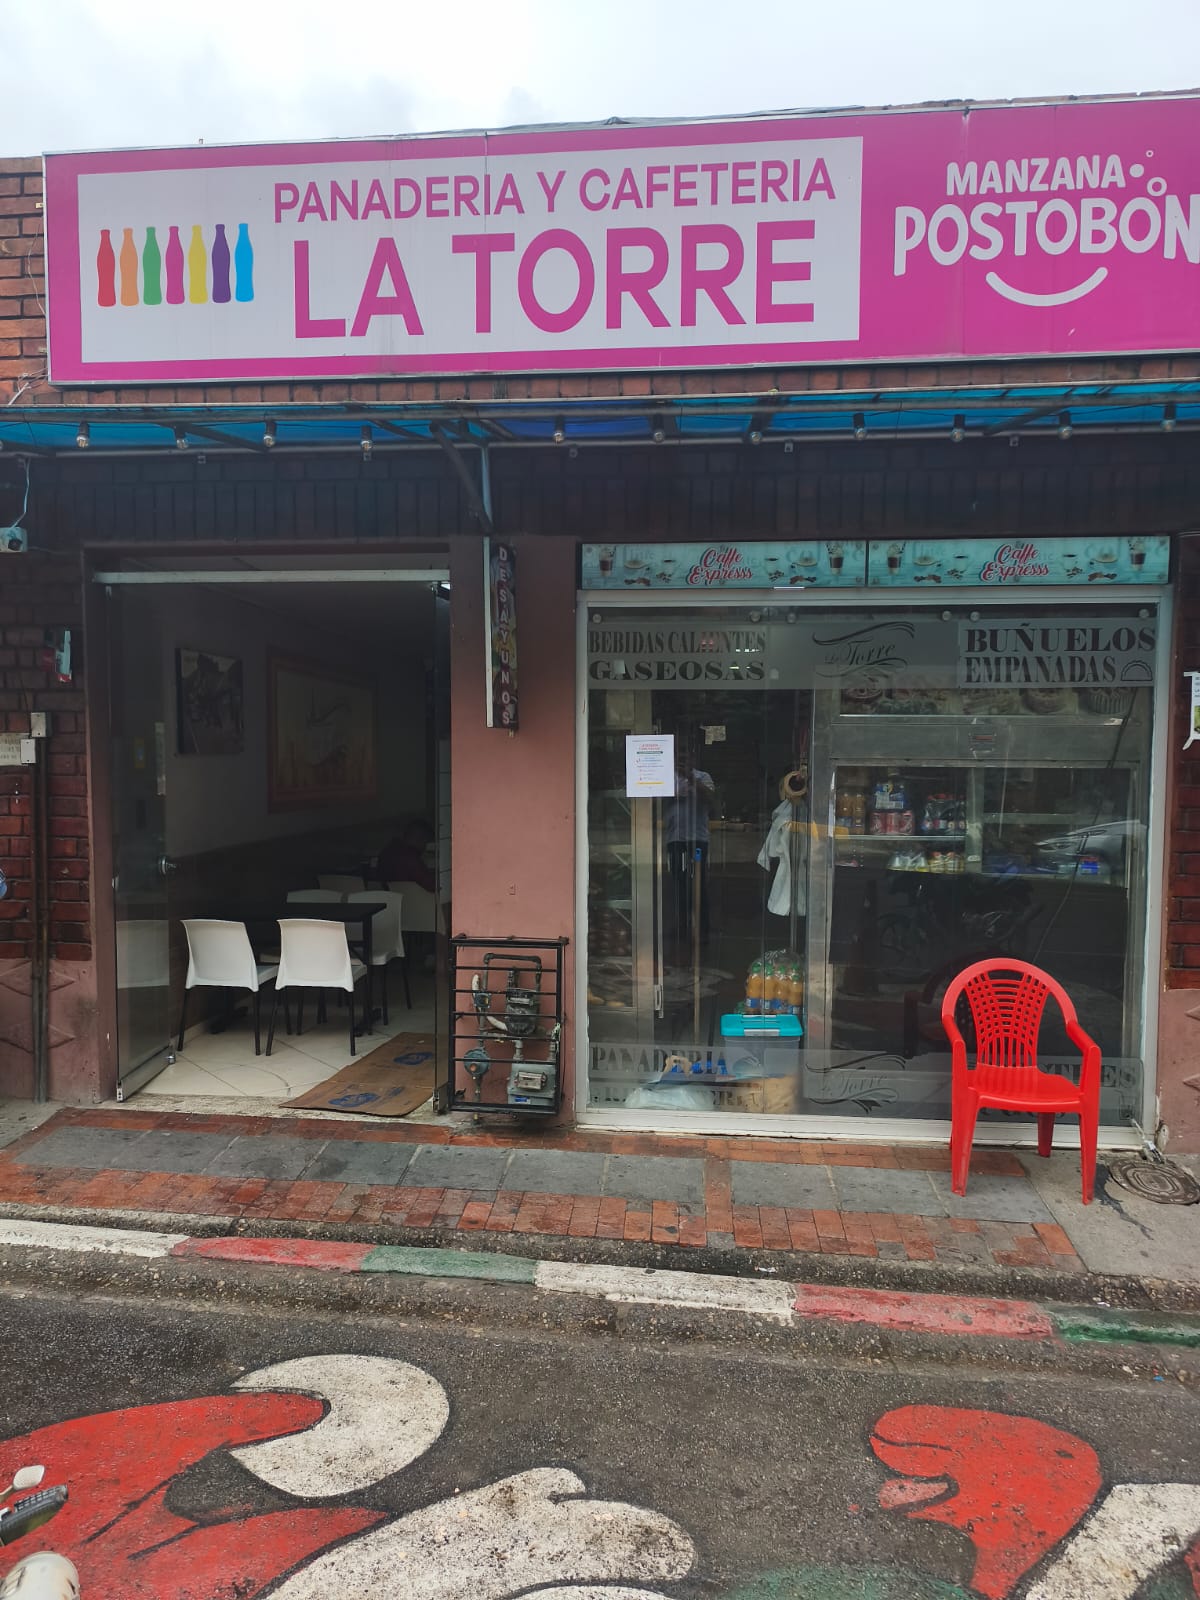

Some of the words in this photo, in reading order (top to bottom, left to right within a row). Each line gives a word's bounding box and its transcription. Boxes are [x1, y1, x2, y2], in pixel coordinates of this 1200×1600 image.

[274, 172, 525, 223] PANADERIA
[536, 170, 567, 213] Y
[579, 157, 836, 212] CAFETERIA
[947, 153, 1126, 196] MANZANA
[294, 237, 425, 338] LA
[452, 219, 816, 333] TORRE
[499, 547, 510, 725] DESAYUNOS
[589, 630, 664, 653] BEBIDAS
[669, 631, 766, 653] CALIENTES
[965, 622, 1156, 652] BUÑUELOS
[589, 660, 766, 681] GASEOSAS
[965, 656, 1116, 683] EMPANADAS
